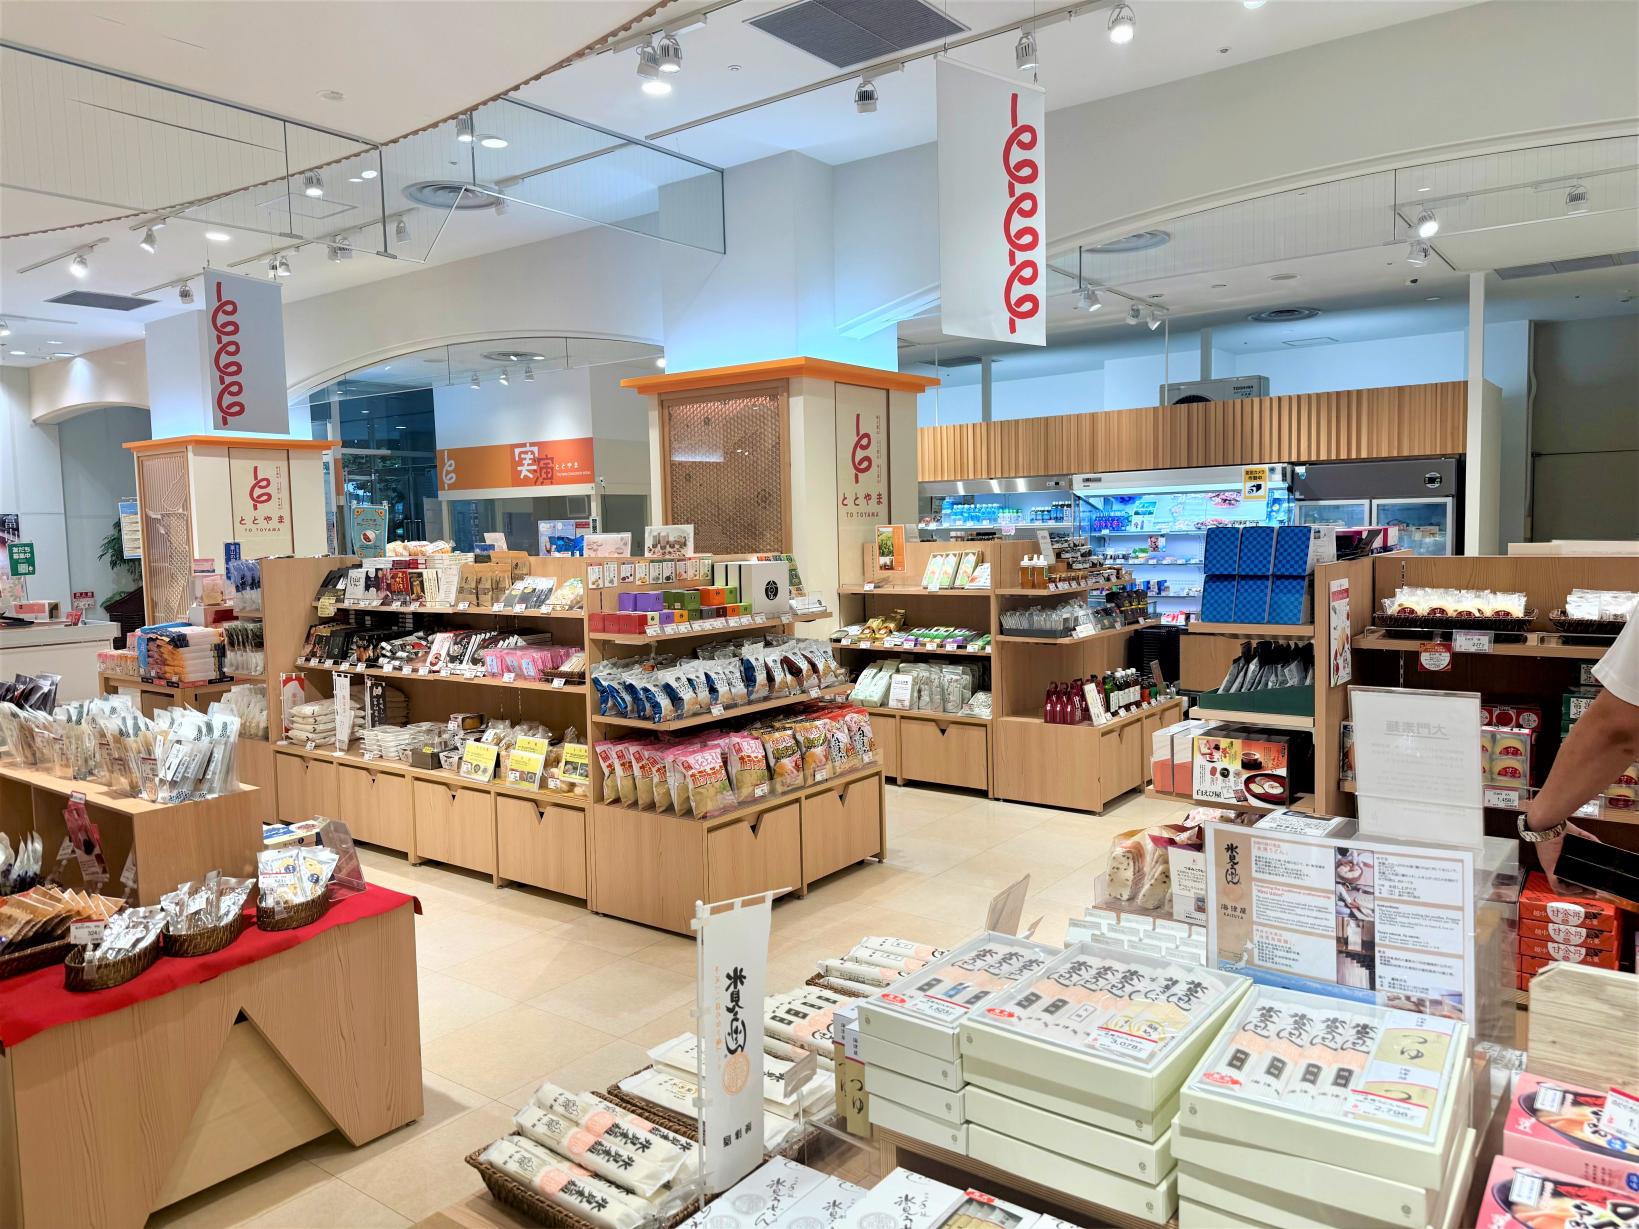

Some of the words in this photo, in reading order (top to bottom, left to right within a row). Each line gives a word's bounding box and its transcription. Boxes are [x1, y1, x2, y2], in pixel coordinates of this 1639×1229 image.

[841, 491, 884, 507] ととやま
[239, 514, 286, 526] ととやま
[1220, 903, 1247, 915] 海津屋
[849, 1078, 865, 1115] つゆ
